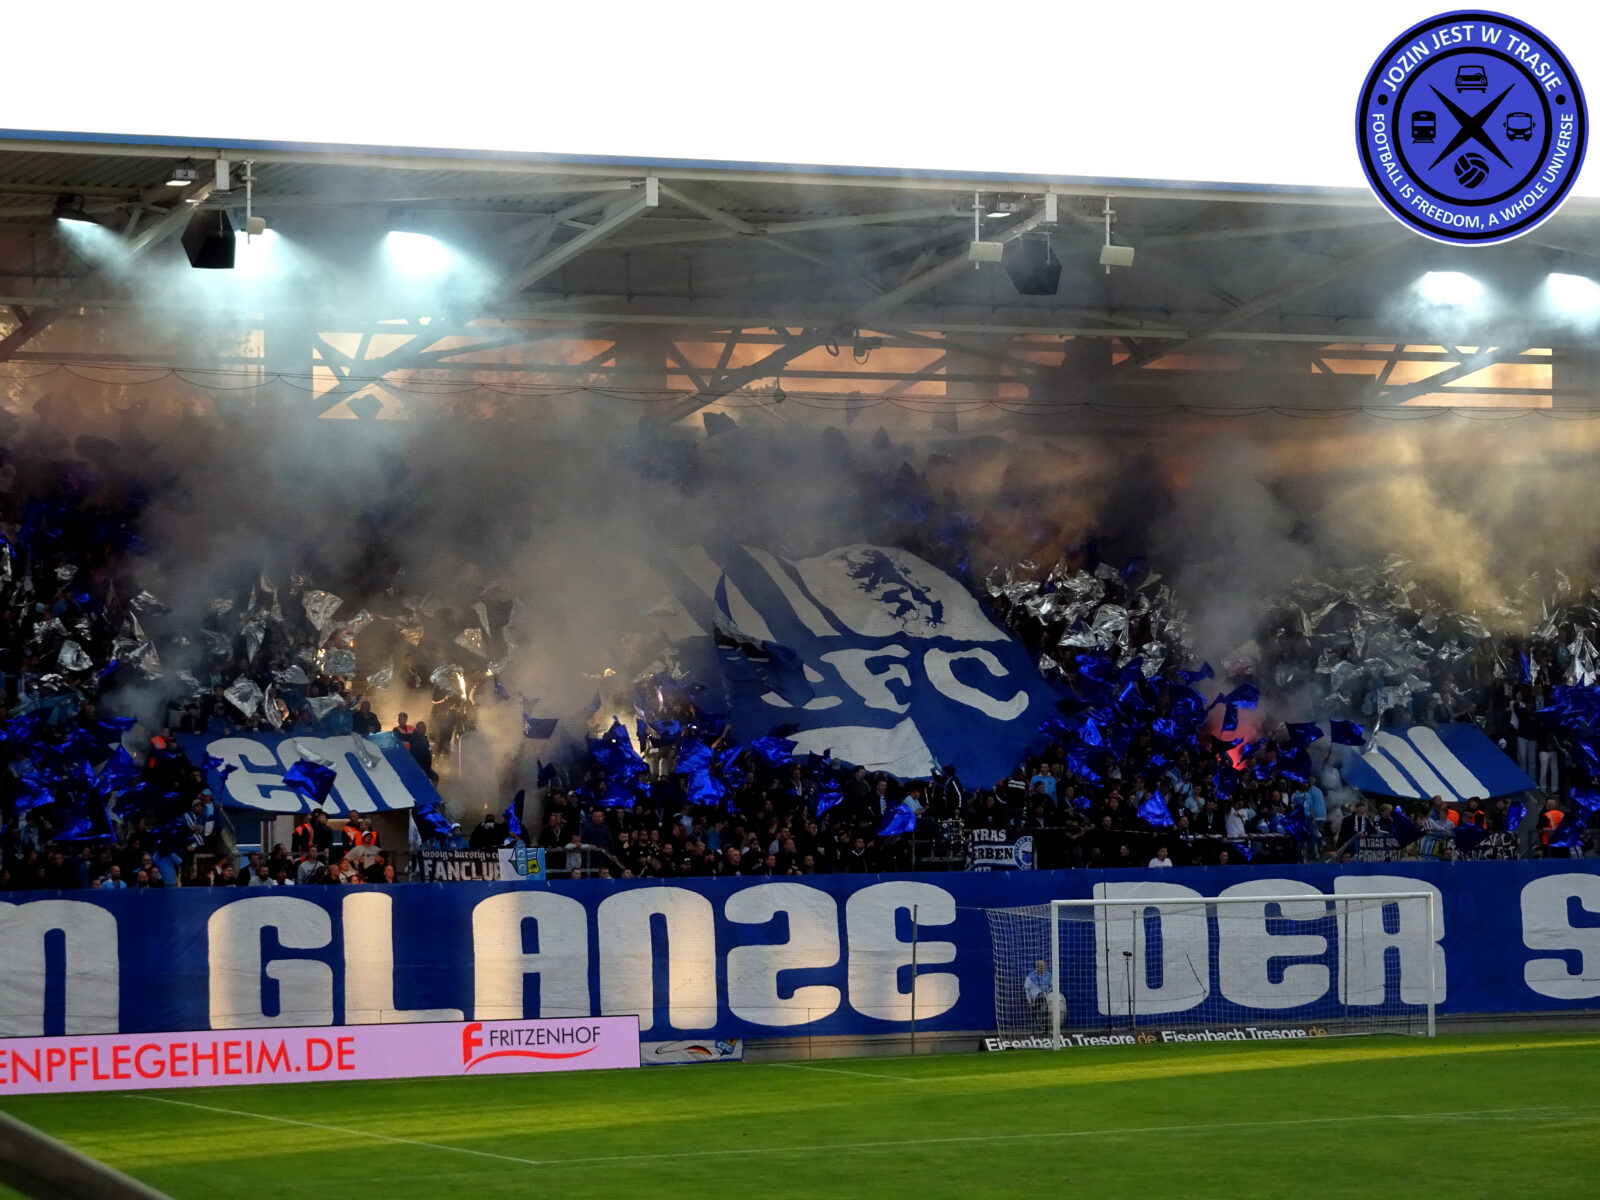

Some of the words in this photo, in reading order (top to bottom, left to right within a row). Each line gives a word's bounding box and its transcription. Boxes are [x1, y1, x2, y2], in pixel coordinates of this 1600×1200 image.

[972, 828, 1006, 842] TRAS
[1093, 875, 1447, 1015] DER
[490, 1026, 600, 1046] FRITZENHOF
[985, 1035, 1072, 1051] Eisenbah
[1072, 1033, 1136, 1046] Tresore
[1161, 1028, 1245, 1042] Eisenbach
[1246, 1027, 1306, 1040] Tresore
